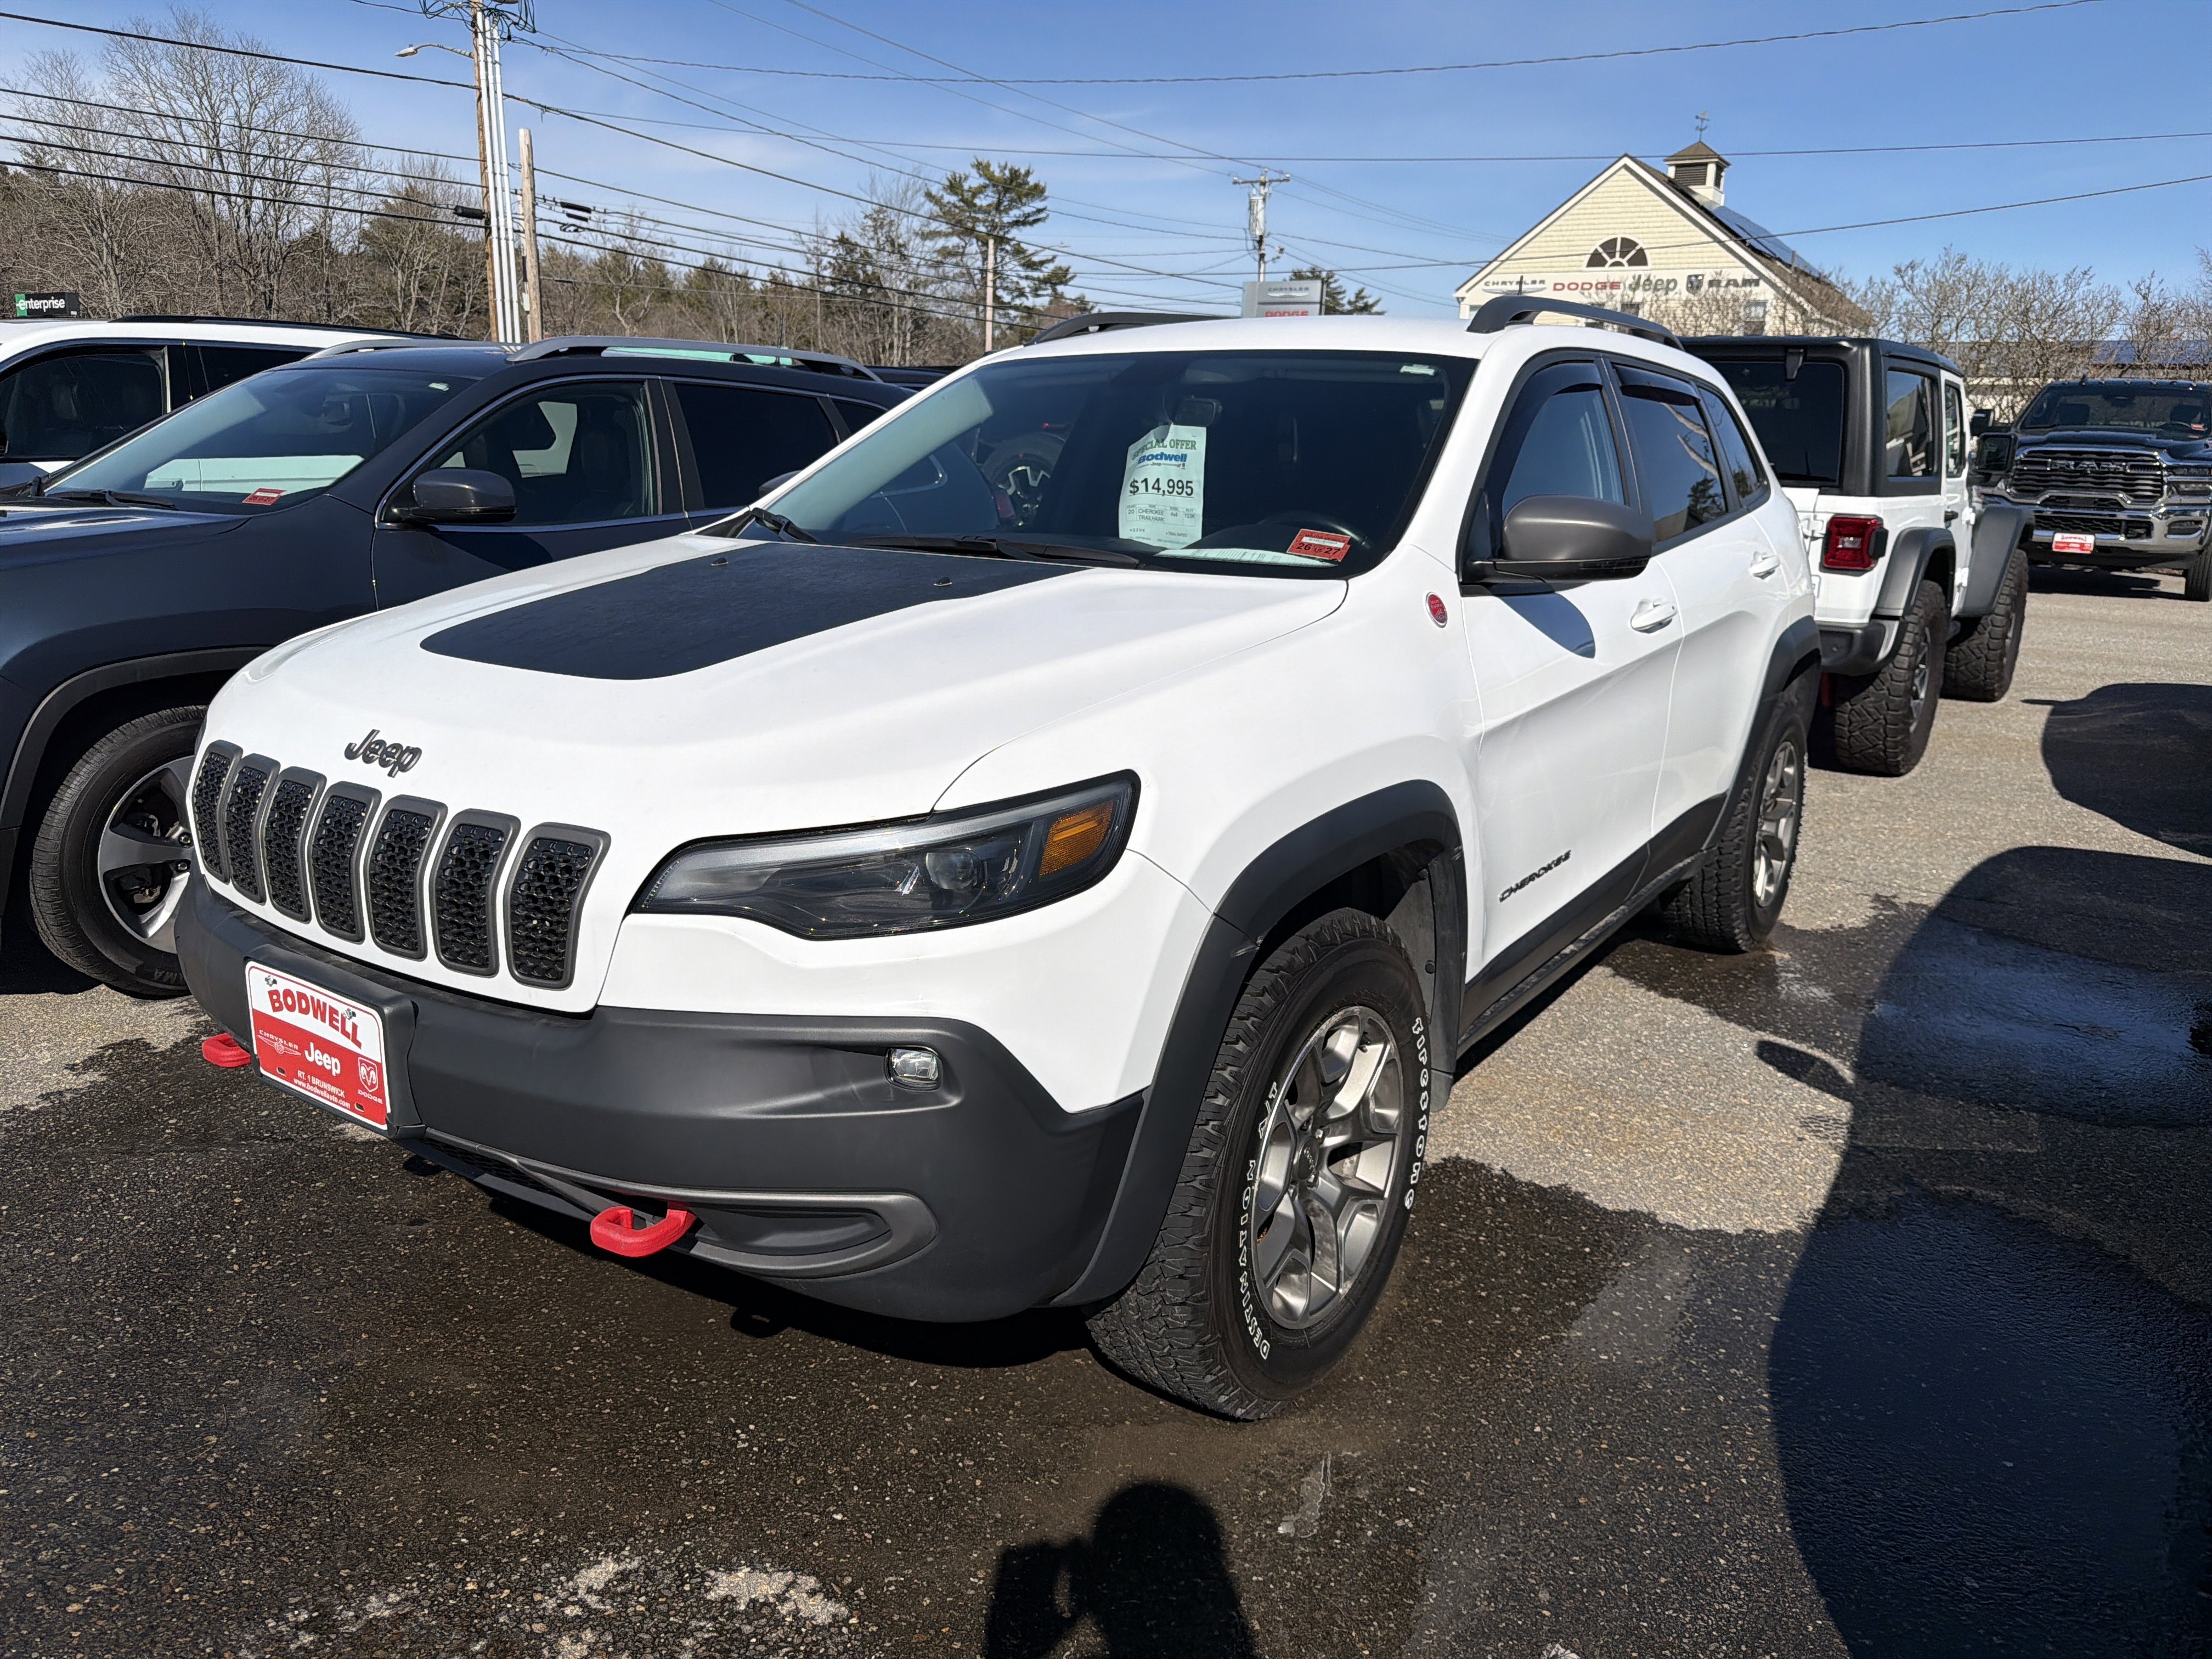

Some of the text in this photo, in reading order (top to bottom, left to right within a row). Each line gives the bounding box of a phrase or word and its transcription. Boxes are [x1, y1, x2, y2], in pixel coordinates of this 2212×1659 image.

[1553, 281, 1621, 291] DODGE
[1628, 274, 1677, 294] Jeep
[16, 297, 65, 312] enterprise
[1132, 439, 1197, 460] SPECIAL OFFER
[1137, 452, 1187, 464] Bodwell
[1129, 478, 1194, 496] $14,995
[345, 729, 422, 778] Jeep
[1499, 849, 1571, 902] CHEROKEE
[268, 989, 362, 1050] BODWELL
[259, 1029, 298, 1051] CHRYSLER
[304, 1042, 341, 1076] Jeep
[358, 1088, 383, 1104] DODGE
[1239, 1160, 1270, 1359] DESTINATION
